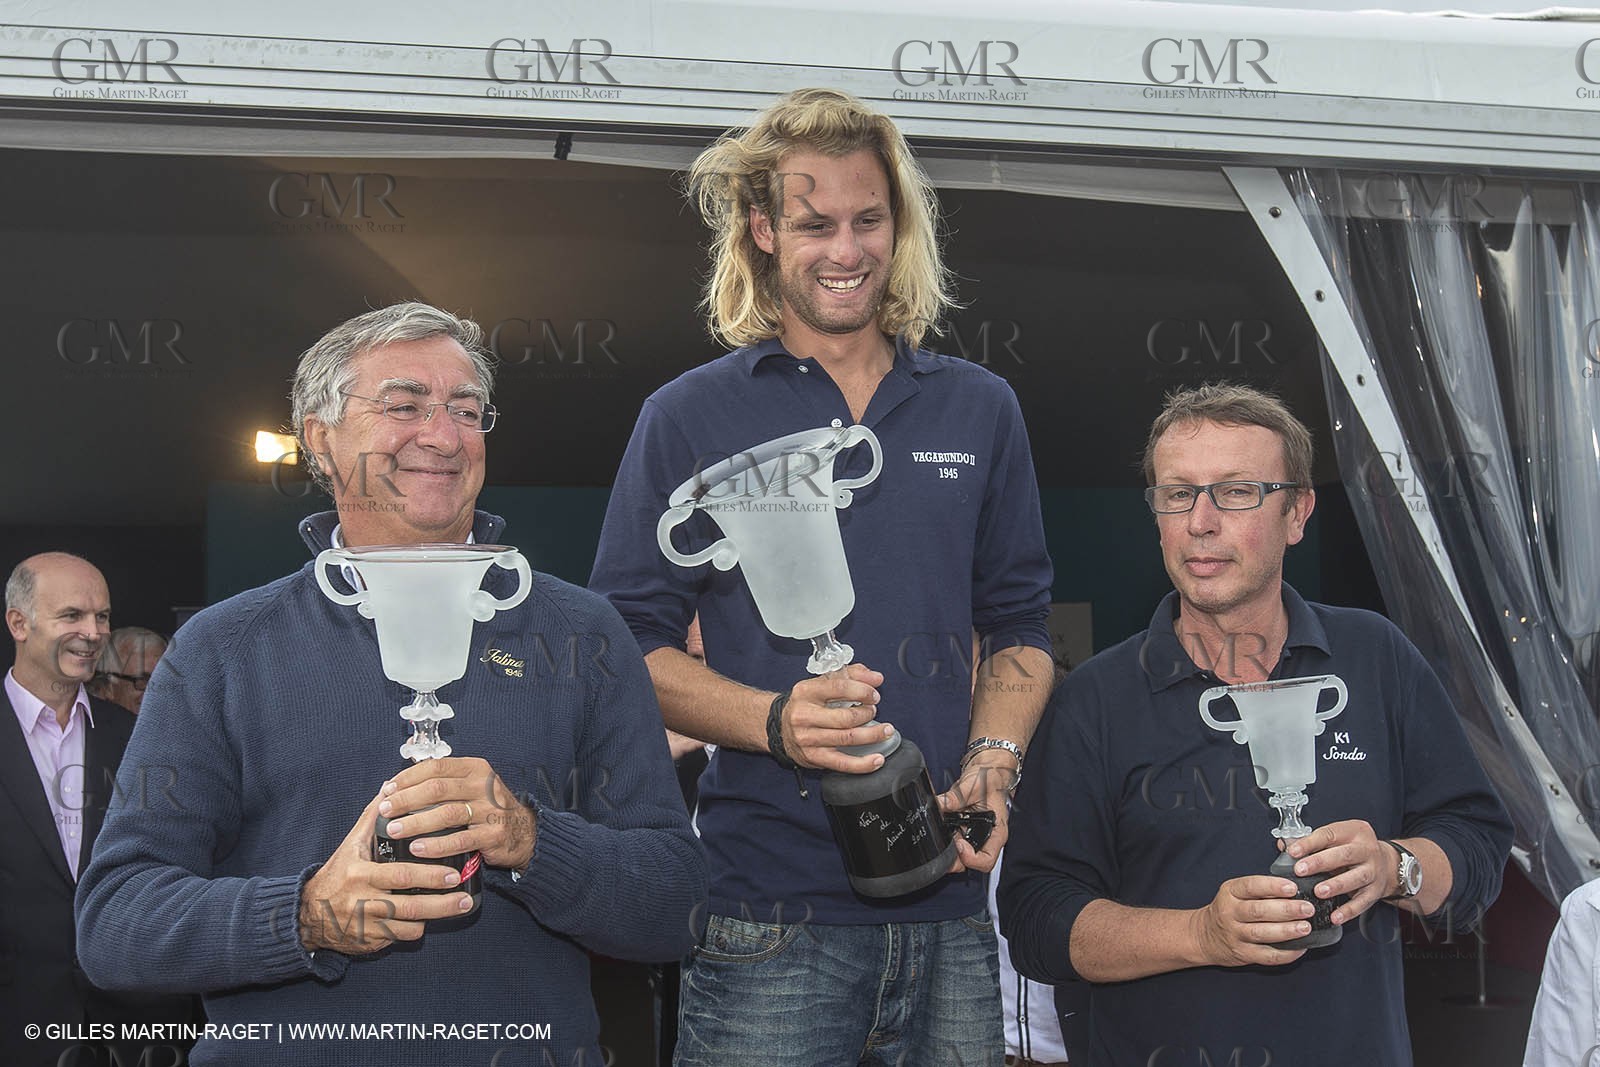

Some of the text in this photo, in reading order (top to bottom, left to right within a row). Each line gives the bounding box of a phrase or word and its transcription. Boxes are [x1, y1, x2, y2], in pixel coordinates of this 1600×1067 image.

[912, 452, 969, 464] VAGABUNDO
[938, 467, 958, 479] 1945
[1334, 732, 1350, 744] K1
[1322, 745, 1367, 761] Sonda
